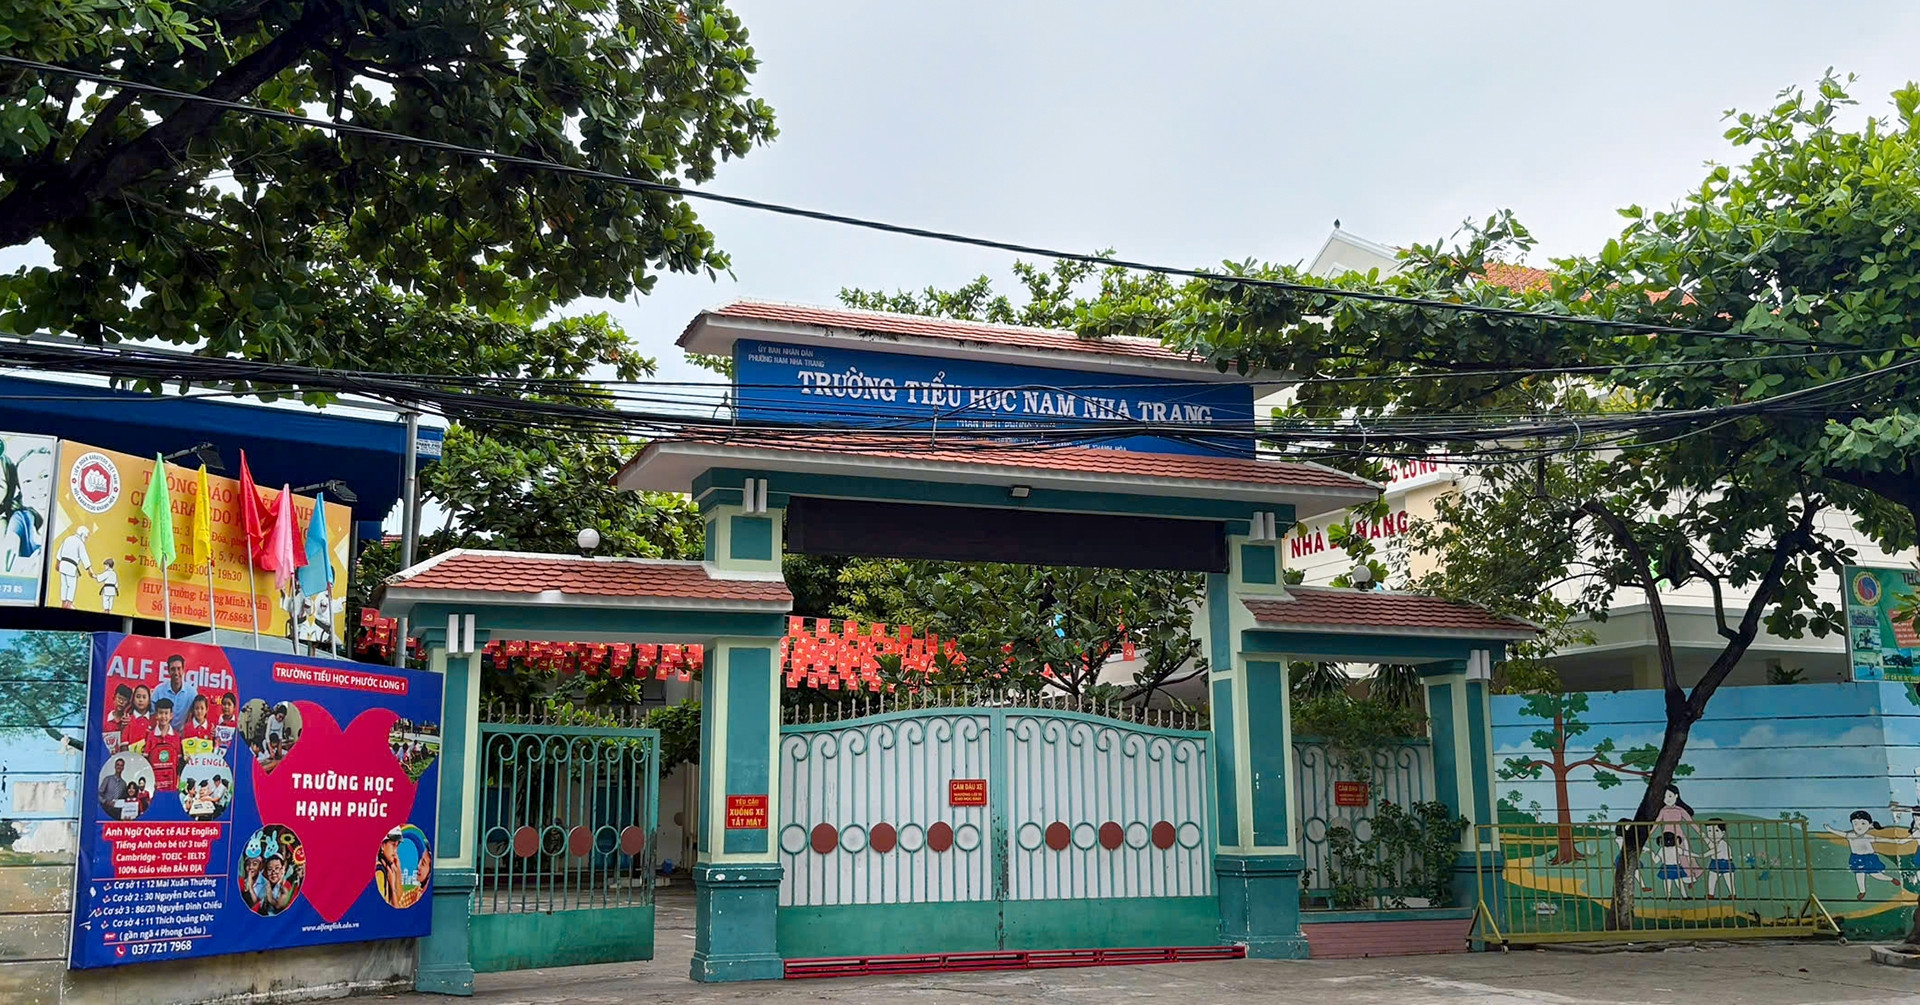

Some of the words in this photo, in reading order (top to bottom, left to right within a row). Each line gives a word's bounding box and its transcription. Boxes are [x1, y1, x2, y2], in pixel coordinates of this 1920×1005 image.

[790, 358, 803, 366] NHA
[804, 359, 825, 368] TRANG
[797, 366, 897, 402] TRƯỜNG
[904, 370, 962, 408] TIỂU
[968, 387, 1017, 417] HỌC
[1023, 391, 1076, 418] NAM
[1083, 396, 1131, 421] NHA
[1137, 401, 1213, 425] TRANG
[143, 470, 198, 496] TÔNG
[208, 480, 232, 503] ÁO
[1291, 525, 1324, 558] NHÀ
[218, 568, 242, 581] 19h30
[143, 583, 162, 595] HLV
[225, 596, 246, 607] Minh
[152, 598, 164, 611] Số
[107, 656, 154, 680] ALF
[158, 661, 233, 690] Eglish
[276, 665, 312, 681] TRƯỜNG
[313, 670, 331, 682] TIỂU
[333, 675, 349, 686] HỌC
[350, 676, 378, 688] PHƯỚC
[379, 680, 400, 690] LONG
[401, 682, 405, 691] 1
[292, 770, 358, 791] TRƯỜNG
[364, 776, 394, 795] HỌC
[296, 800, 342, 821] HẠNH
[347, 798, 388, 818] PHÚC
[755, 808, 765, 816] XE
[105, 827, 122, 836] Anh
[124, 827, 142, 838] Ngữ
[144, 826, 164, 838] Quốc
[166, 826, 175, 836] tế
[176, 827, 190, 836] ALF
[191, 827, 218, 839] English
[116, 841, 137, 850] Tiếng
[137, 840, 153, 849] Anh
[153, 840, 167, 849] cho
[168, 840, 177, 848] bé
[188, 840, 193, 848] 3
[116, 853, 156, 863] Cambridge
[161, 852, 182, 861] TOEIC
[187, 852, 206, 860] IELTS
[118, 866, 137, 874] 100%
[138, 865, 155, 874] Giáo
[156, 864, 172, 873] viên
[173, 863, 188, 873] BẢN
[190, 864, 203, 873] ĐỊA
[114, 881, 125, 890] Cơ
[125, 879, 135, 889] sở
[136, 881, 140, 889] 1
[146, 881, 155, 889] 12
[156, 879, 169, 888] Mai
[171, 878, 189, 887] Xuân
[112, 894, 124, 902] Cơ
[124, 892, 134, 902] sở
[134, 893, 140, 901] 2
[144, 893, 153, 901] 30
[155, 890, 181, 902] Nguyễn
[183, 890, 197, 899] Đức
[103, 907, 114, 915] Cơ
[114, 905, 124, 915] sở
[125, 906, 130, 914] 3
[135, 905, 155, 914] 86/20
[157, 902, 184, 915] Nguyễn
[112, 919, 124, 928] Cơ
[124, 917, 134, 927] sở
[134, 918, 140, 926] 4
[145, 918, 153, 926] 11
[155, 915, 174, 925] Thích
[199, 912, 214, 922] Đức
[123, 931, 139, 941] gần
[155, 929, 159, 937] 4
[160, 927, 183, 939] Phong
[184, 926, 202, 935] Châu
[132, 944, 149, 955] 037
[151, 942, 167, 954] 721
[170, 940, 192, 952] 7968
